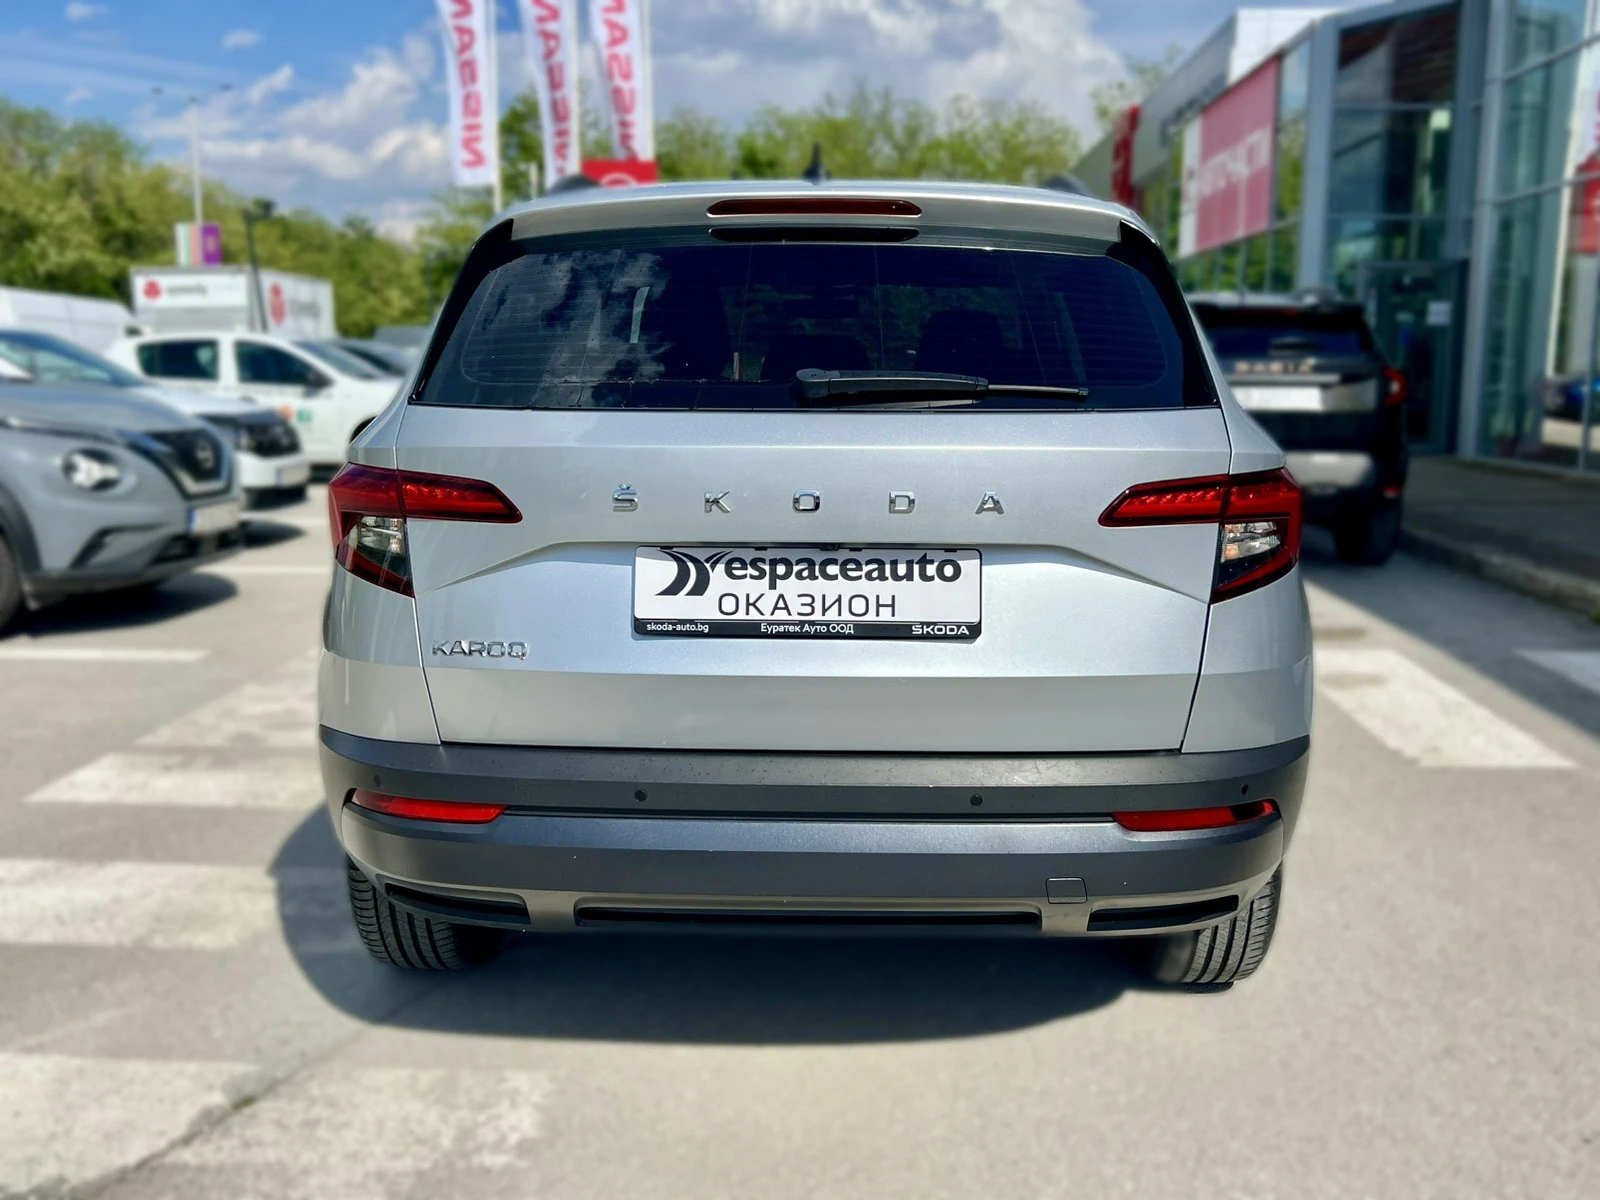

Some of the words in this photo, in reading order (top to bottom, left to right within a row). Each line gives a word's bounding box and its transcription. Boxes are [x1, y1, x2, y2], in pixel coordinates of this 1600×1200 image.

[611, 483, 1005, 514] ŠKODA
[724, 552, 962, 590] espaceauto
[717, 592, 897, 618] ОКАЗИОН
[646, 622, 709, 633] skoda-auto.bg
[760, 623, 801, 634] Еуратек
[803, 624, 827, 634] Ауто
[829, 624, 854, 635] ООД
[911, 623, 970, 635] ŠKODA
[432, 640, 528, 660] KAROQ
